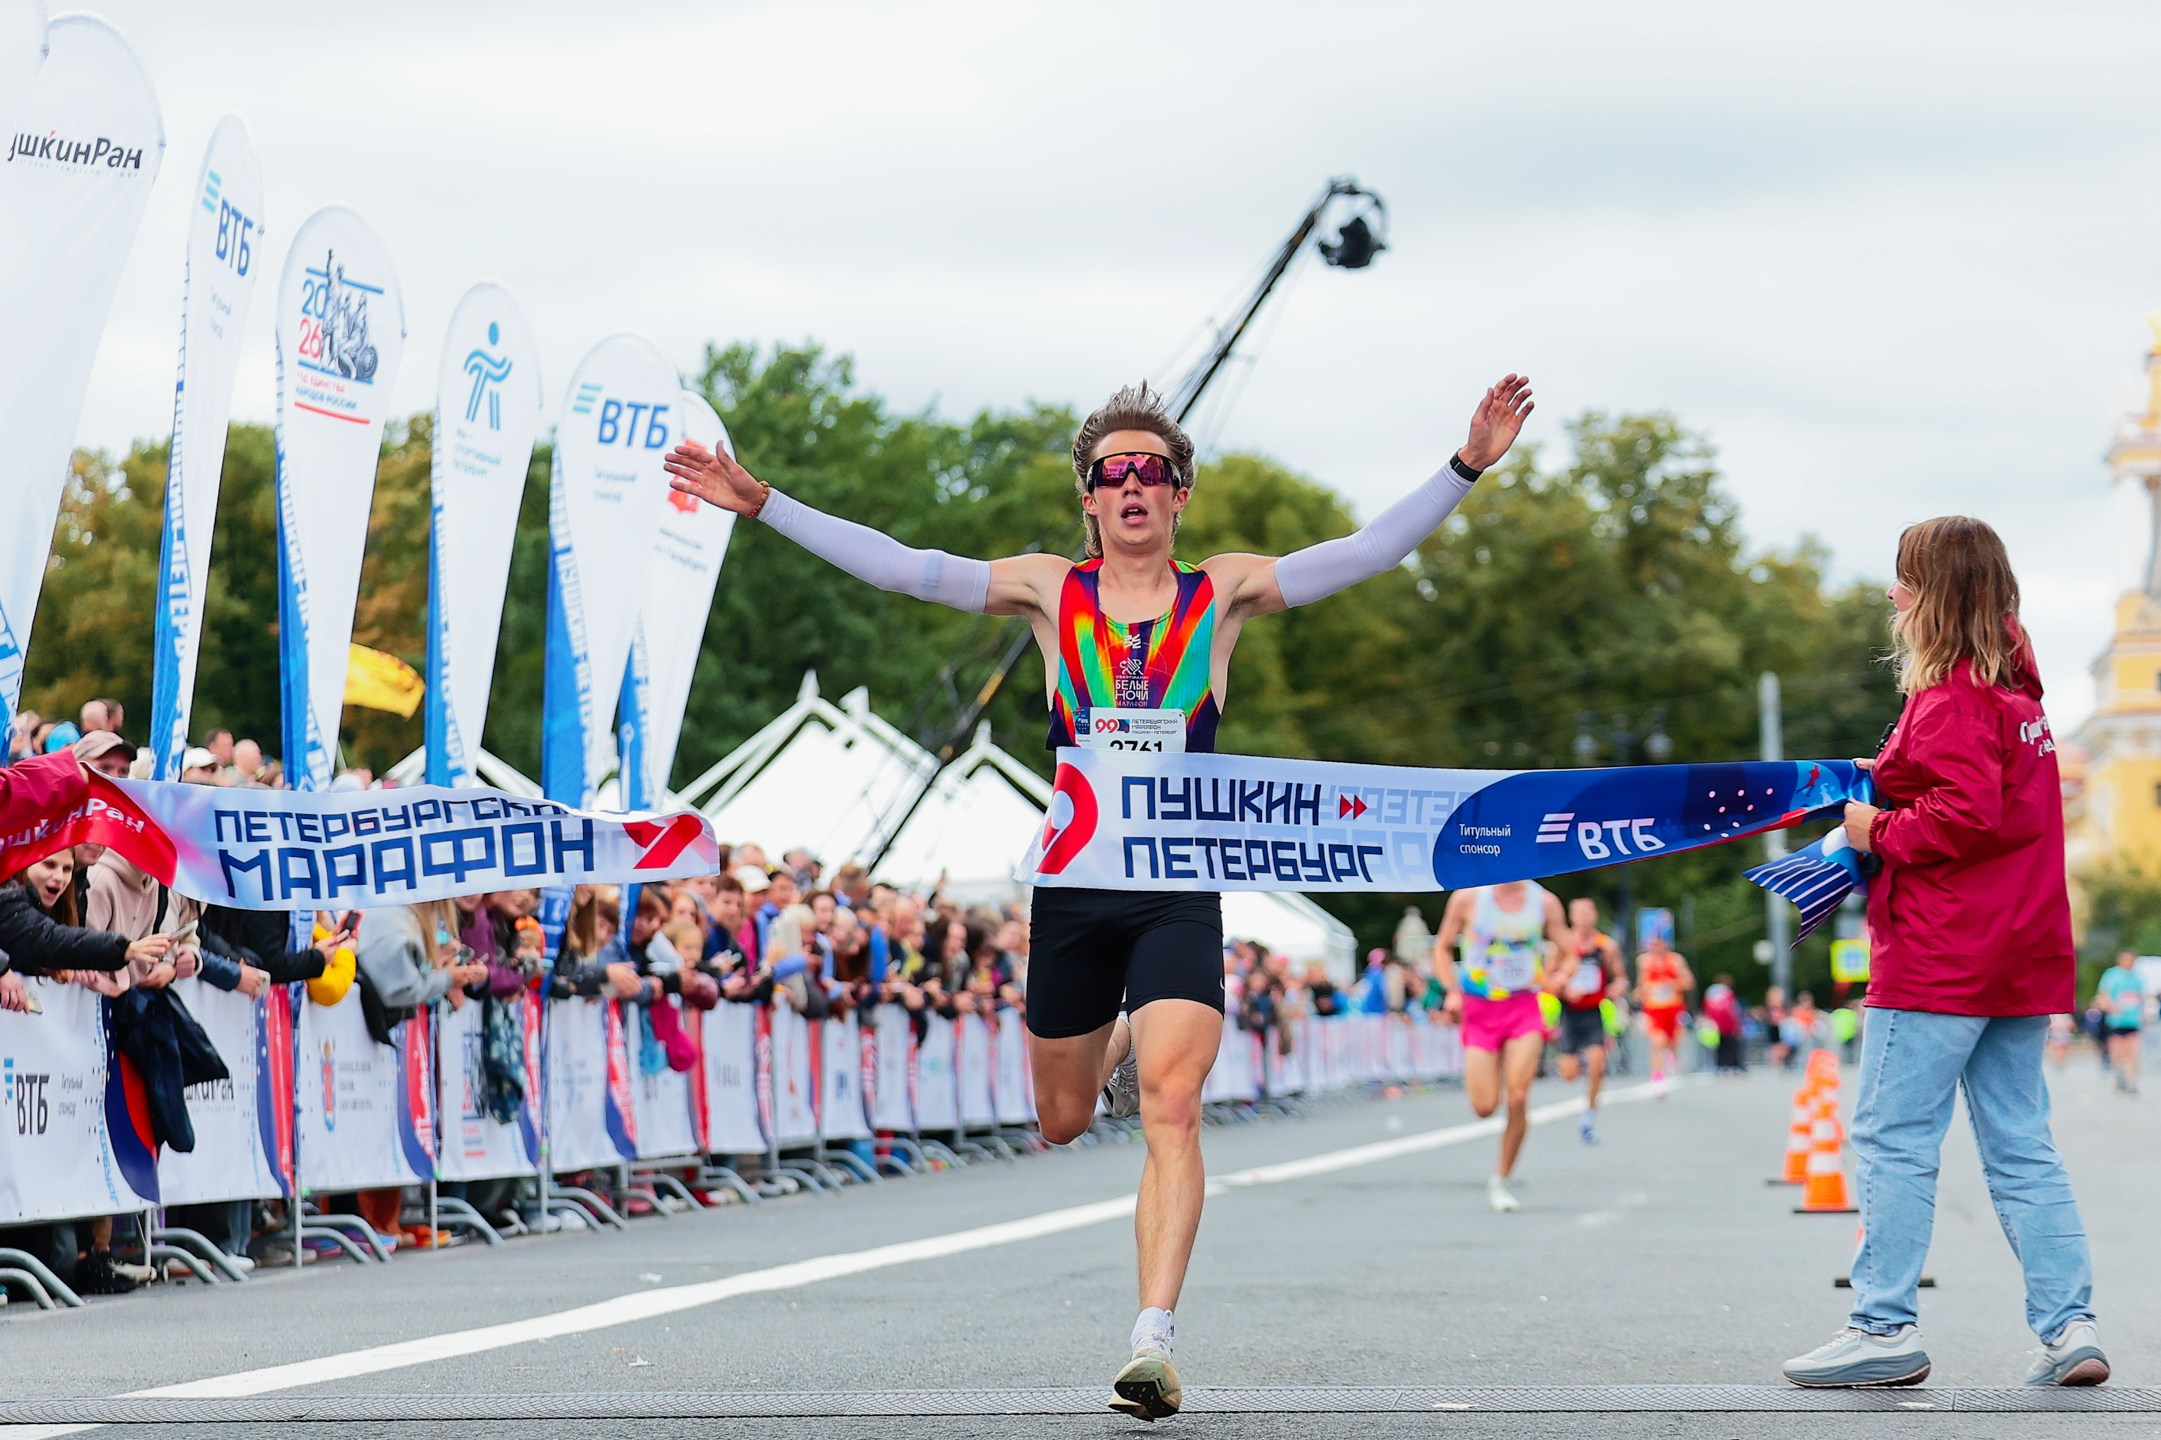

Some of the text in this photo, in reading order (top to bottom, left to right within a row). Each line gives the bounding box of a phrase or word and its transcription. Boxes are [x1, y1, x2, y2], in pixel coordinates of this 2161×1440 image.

[216, 197, 254, 277] ВТБ
[302, 279, 328, 320] 20
[298, 318, 323, 359] 26
[598, 397, 670, 450] ВТБ
[1115, 680, 1149, 690] БЕЛЫЕ
[1115, 690, 1149, 701] НОЧИ
[1095, 718, 1119, 734] 99
[214, 797, 568, 844] ПЕТЕРБУРГСК
[1121, 775, 1322, 826] ПУШКИН
[1459, 824, 1511, 839] Титульный
[1460, 844, 1501, 857] спонсор
[1577, 817, 1666, 861] ВТБ
[219, 818, 594, 902] МАРАФОН
[1122, 836, 1384, 883] ПЕТЕРБУРГ
[16, 1073, 50, 1135] ВТБ
